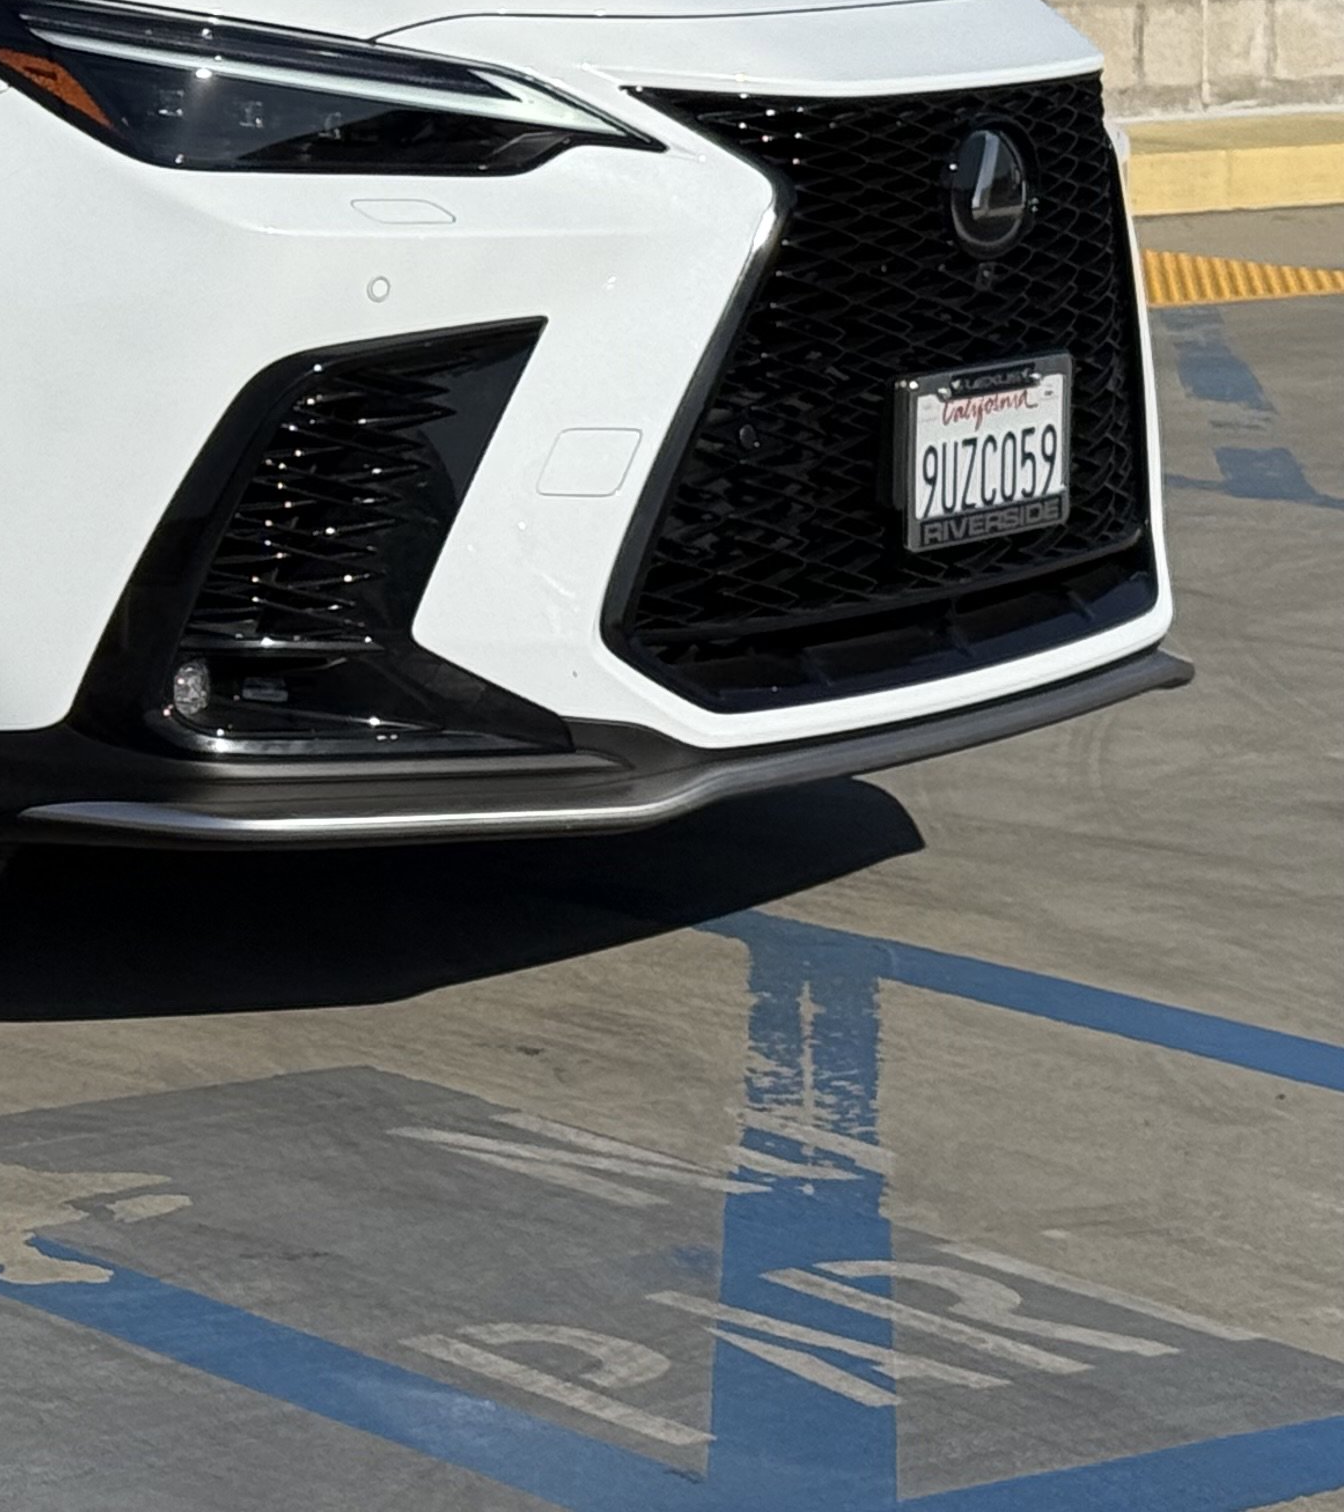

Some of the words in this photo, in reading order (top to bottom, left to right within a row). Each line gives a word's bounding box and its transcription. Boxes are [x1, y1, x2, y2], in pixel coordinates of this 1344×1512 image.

[941, 388, 1038, 432] California
[922, 424, 1058, 519] 9UZC059
[922, 498, 1061, 546] RIVERSIDE
